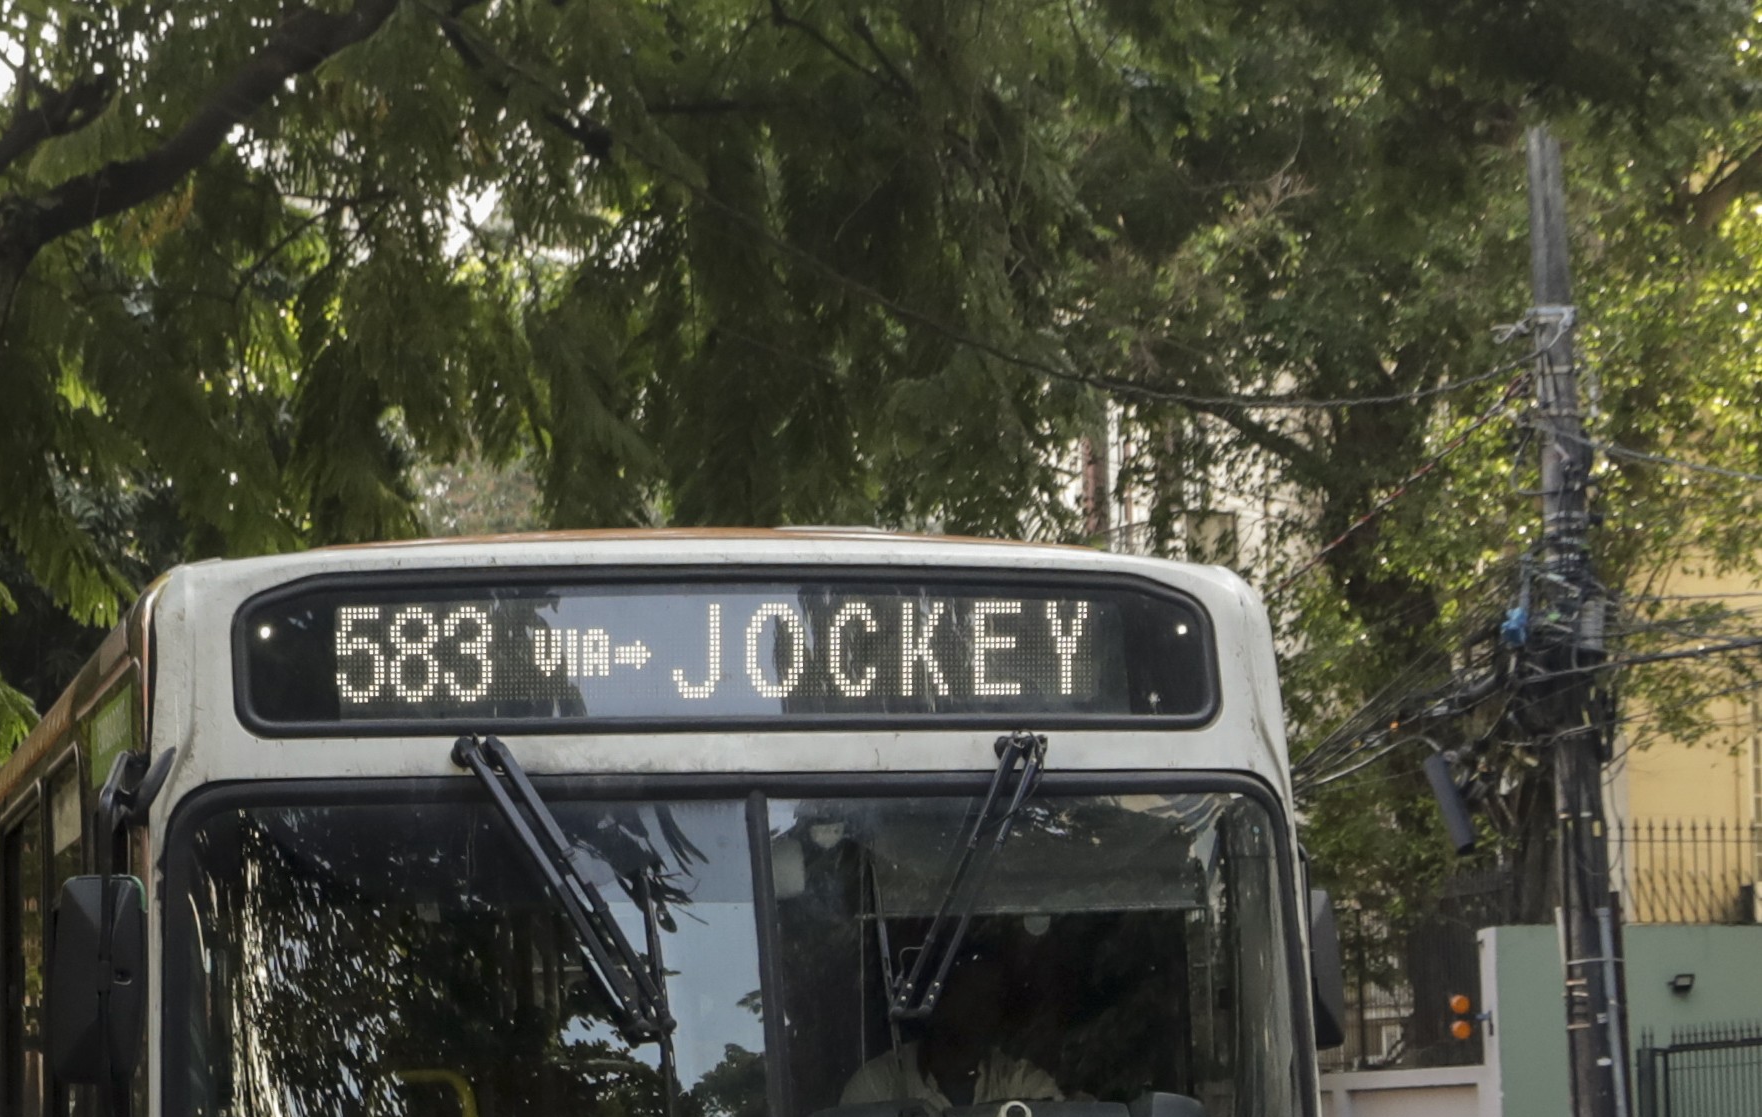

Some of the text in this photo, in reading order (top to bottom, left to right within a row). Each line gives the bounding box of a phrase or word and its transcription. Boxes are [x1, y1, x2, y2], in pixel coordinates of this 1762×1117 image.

[334, 601, 1089, 703] 583 VIA JOCKEY
